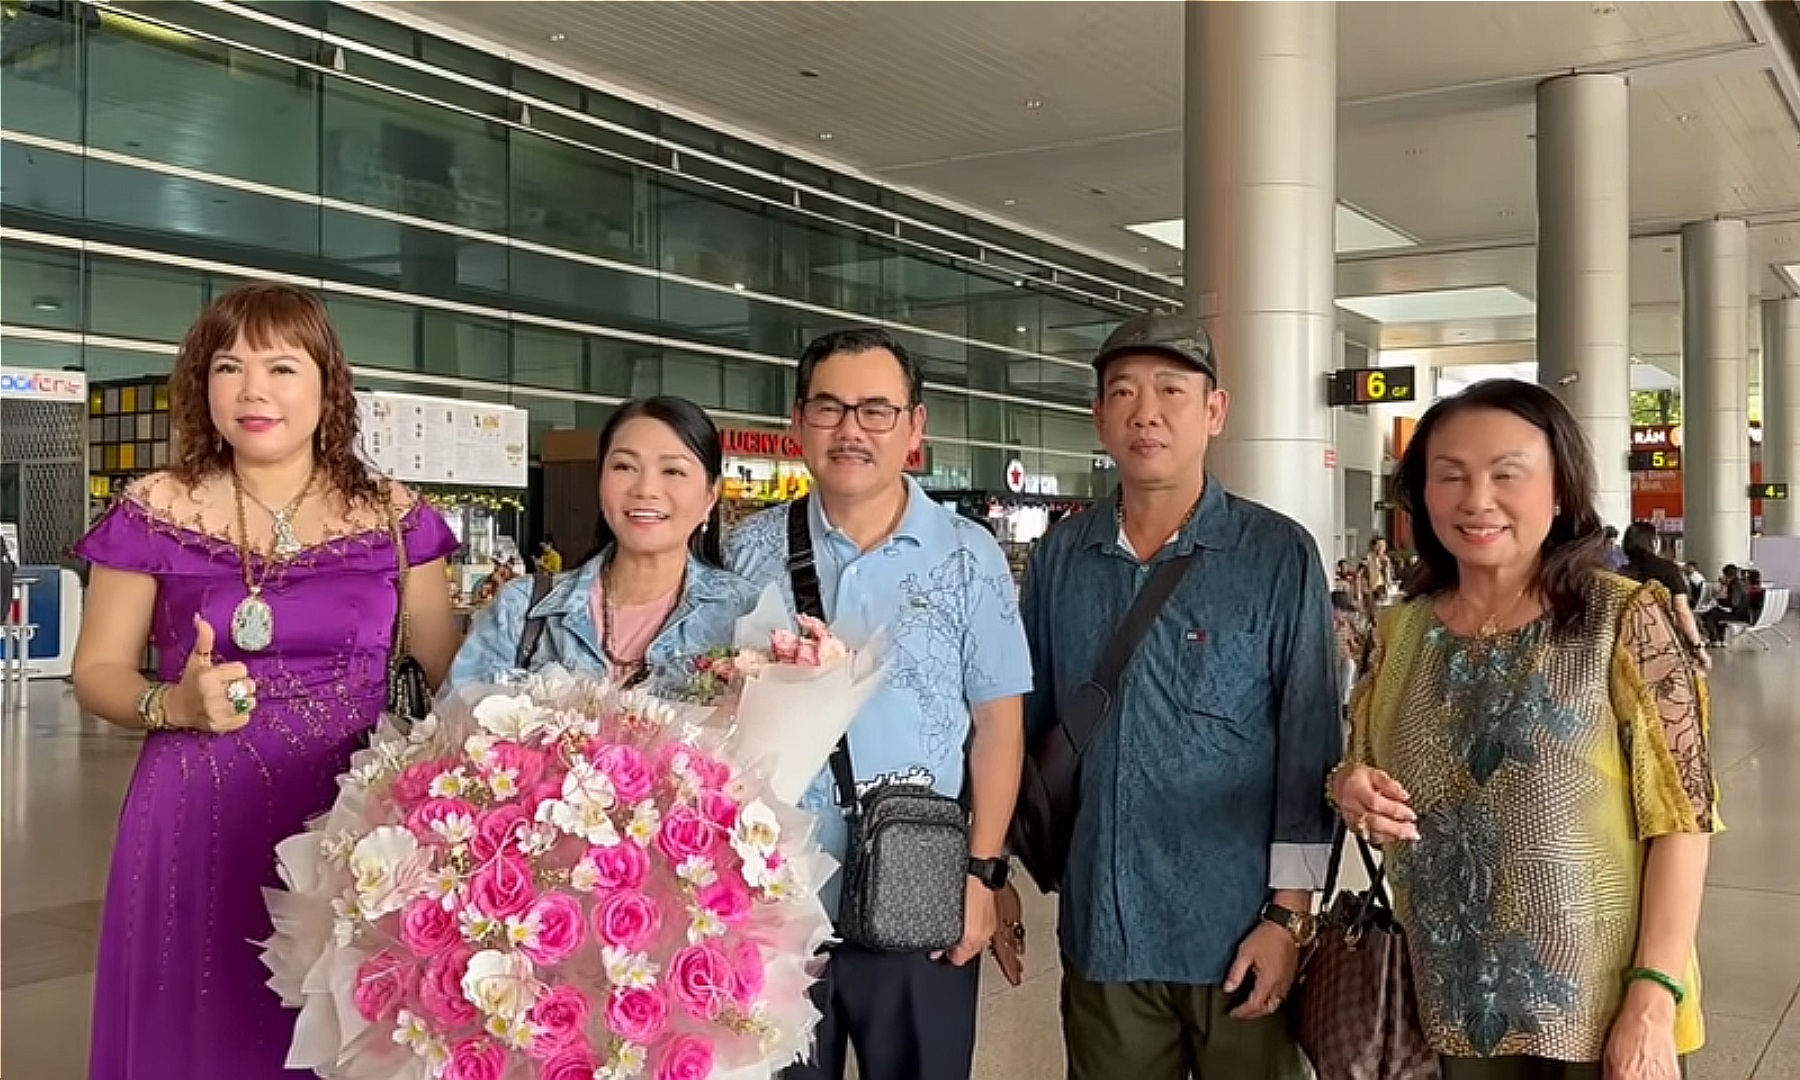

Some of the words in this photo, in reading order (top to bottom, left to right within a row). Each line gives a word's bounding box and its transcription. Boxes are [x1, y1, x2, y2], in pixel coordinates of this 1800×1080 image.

[1368, 371, 1386, 398] 6
[721, 429, 778, 453] LUCKY
[1653, 451, 1665, 467] 5
[1765, 485, 1775, 498] 4
